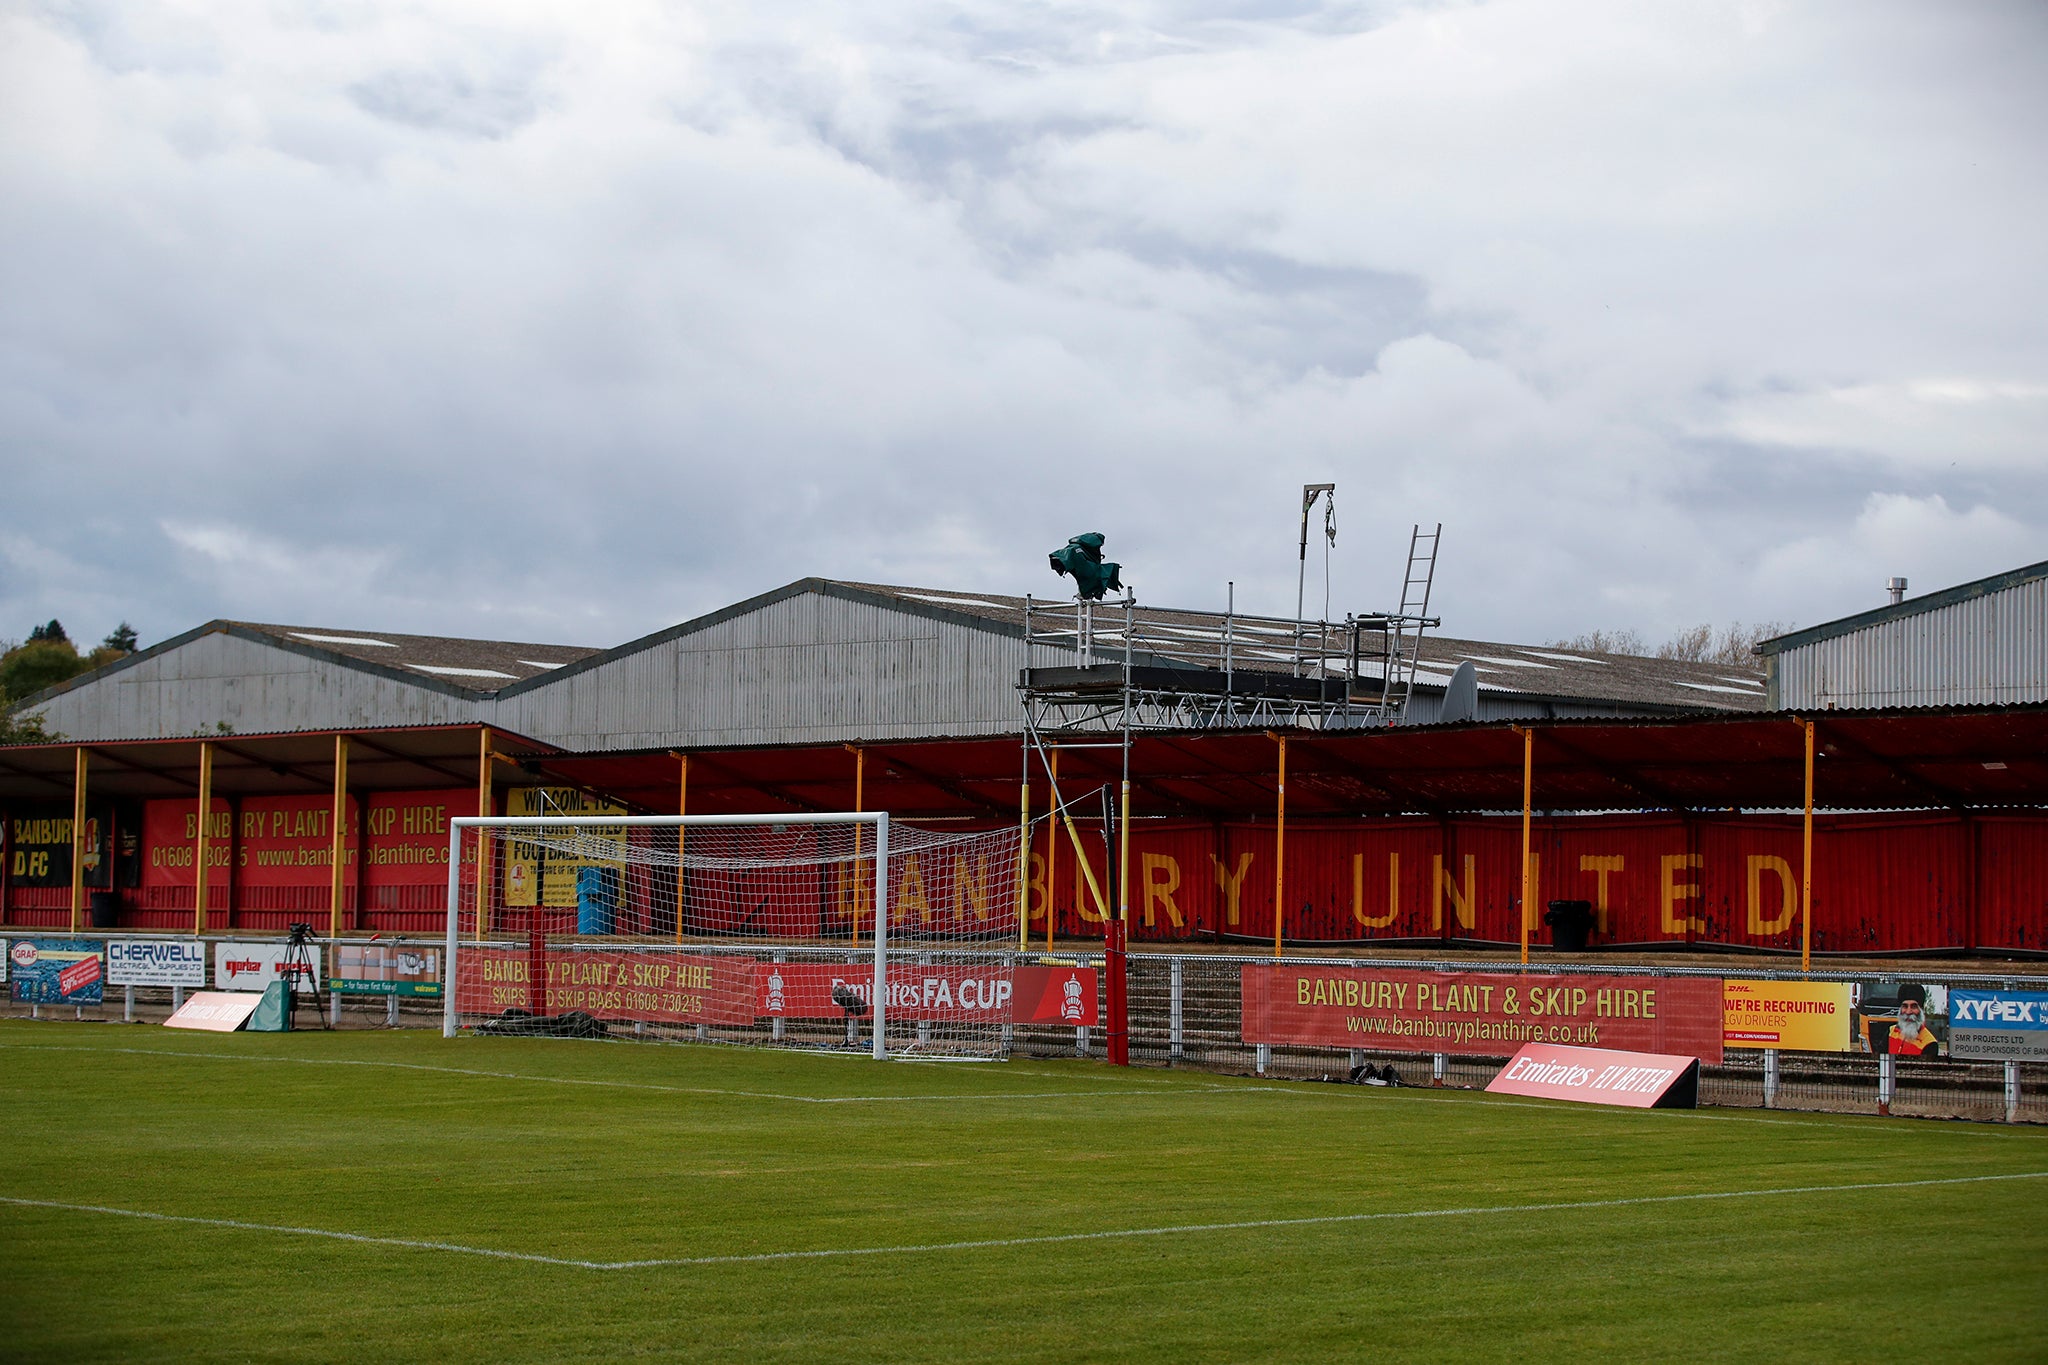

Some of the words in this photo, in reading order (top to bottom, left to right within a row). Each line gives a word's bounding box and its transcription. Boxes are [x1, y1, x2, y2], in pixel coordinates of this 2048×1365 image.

[524, 789, 588, 811] WLCOME
[185, 811, 266, 839] BNBRY
[272, 809, 330, 838] PLANT
[403, 805, 446, 834] HIRE
[152, 846, 192, 868] 01608
[205, 845, 248, 867] 3025
[1353, 852, 1797, 936] UNITED
[15, 949, 37, 959] GRAF
[484, 959, 555, 984] BANBUY
[561, 962, 611, 986] PLANT
[616, 963, 628, 986] &
[633, 964, 670, 987] SKIP
[676, 966, 713, 989] HIRE
[492, 987, 526, 1005] SKIPS
[557, 990, 585, 1008] SKIP
[588, 991, 621, 1009] BAGS
[626, 992, 658, 1011] 01608
[662, 993, 702, 1013] 730215
[831, 978, 919, 1006] Emiates
[923, 979, 953, 1008] FA
[958, 978, 1012, 1009] CUP
[1297, 978, 1408, 1010] BANBURY
[1417, 983, 1494, 1013] PLANT
[1503, 986, 1520, 1015] &
[1529, 986, 1587, 1017] SKIP
[1596, 988, 1656, 1019] HIRE
[1723, 999, 1761, 1012] WE'RE
[1764, 1000, 1835, 1014] RECRUITING
[1724, 1014, 1743, 1025] LGV
[1745, 1014, 1787, 1027] DRIVERS
[1955, 995, 2034, 1022] XYPEX
[1346, 1014, 1599, 1044] www.banburyplanthire.co.uk
[1955, 1034, 1971, 1042] SMR
[1973, 1035, 2009, 1044] PROJECTS
[1955, 1045, 1980, 1053] PROUD
[1982, 1046, 2020, 1055] SPONSORS
[2022, 1047, 2032, 1055] OF
[1505, 1056, 1595, 1087] Emirates
[1612, 1066, 1674, 1093] BETTER
